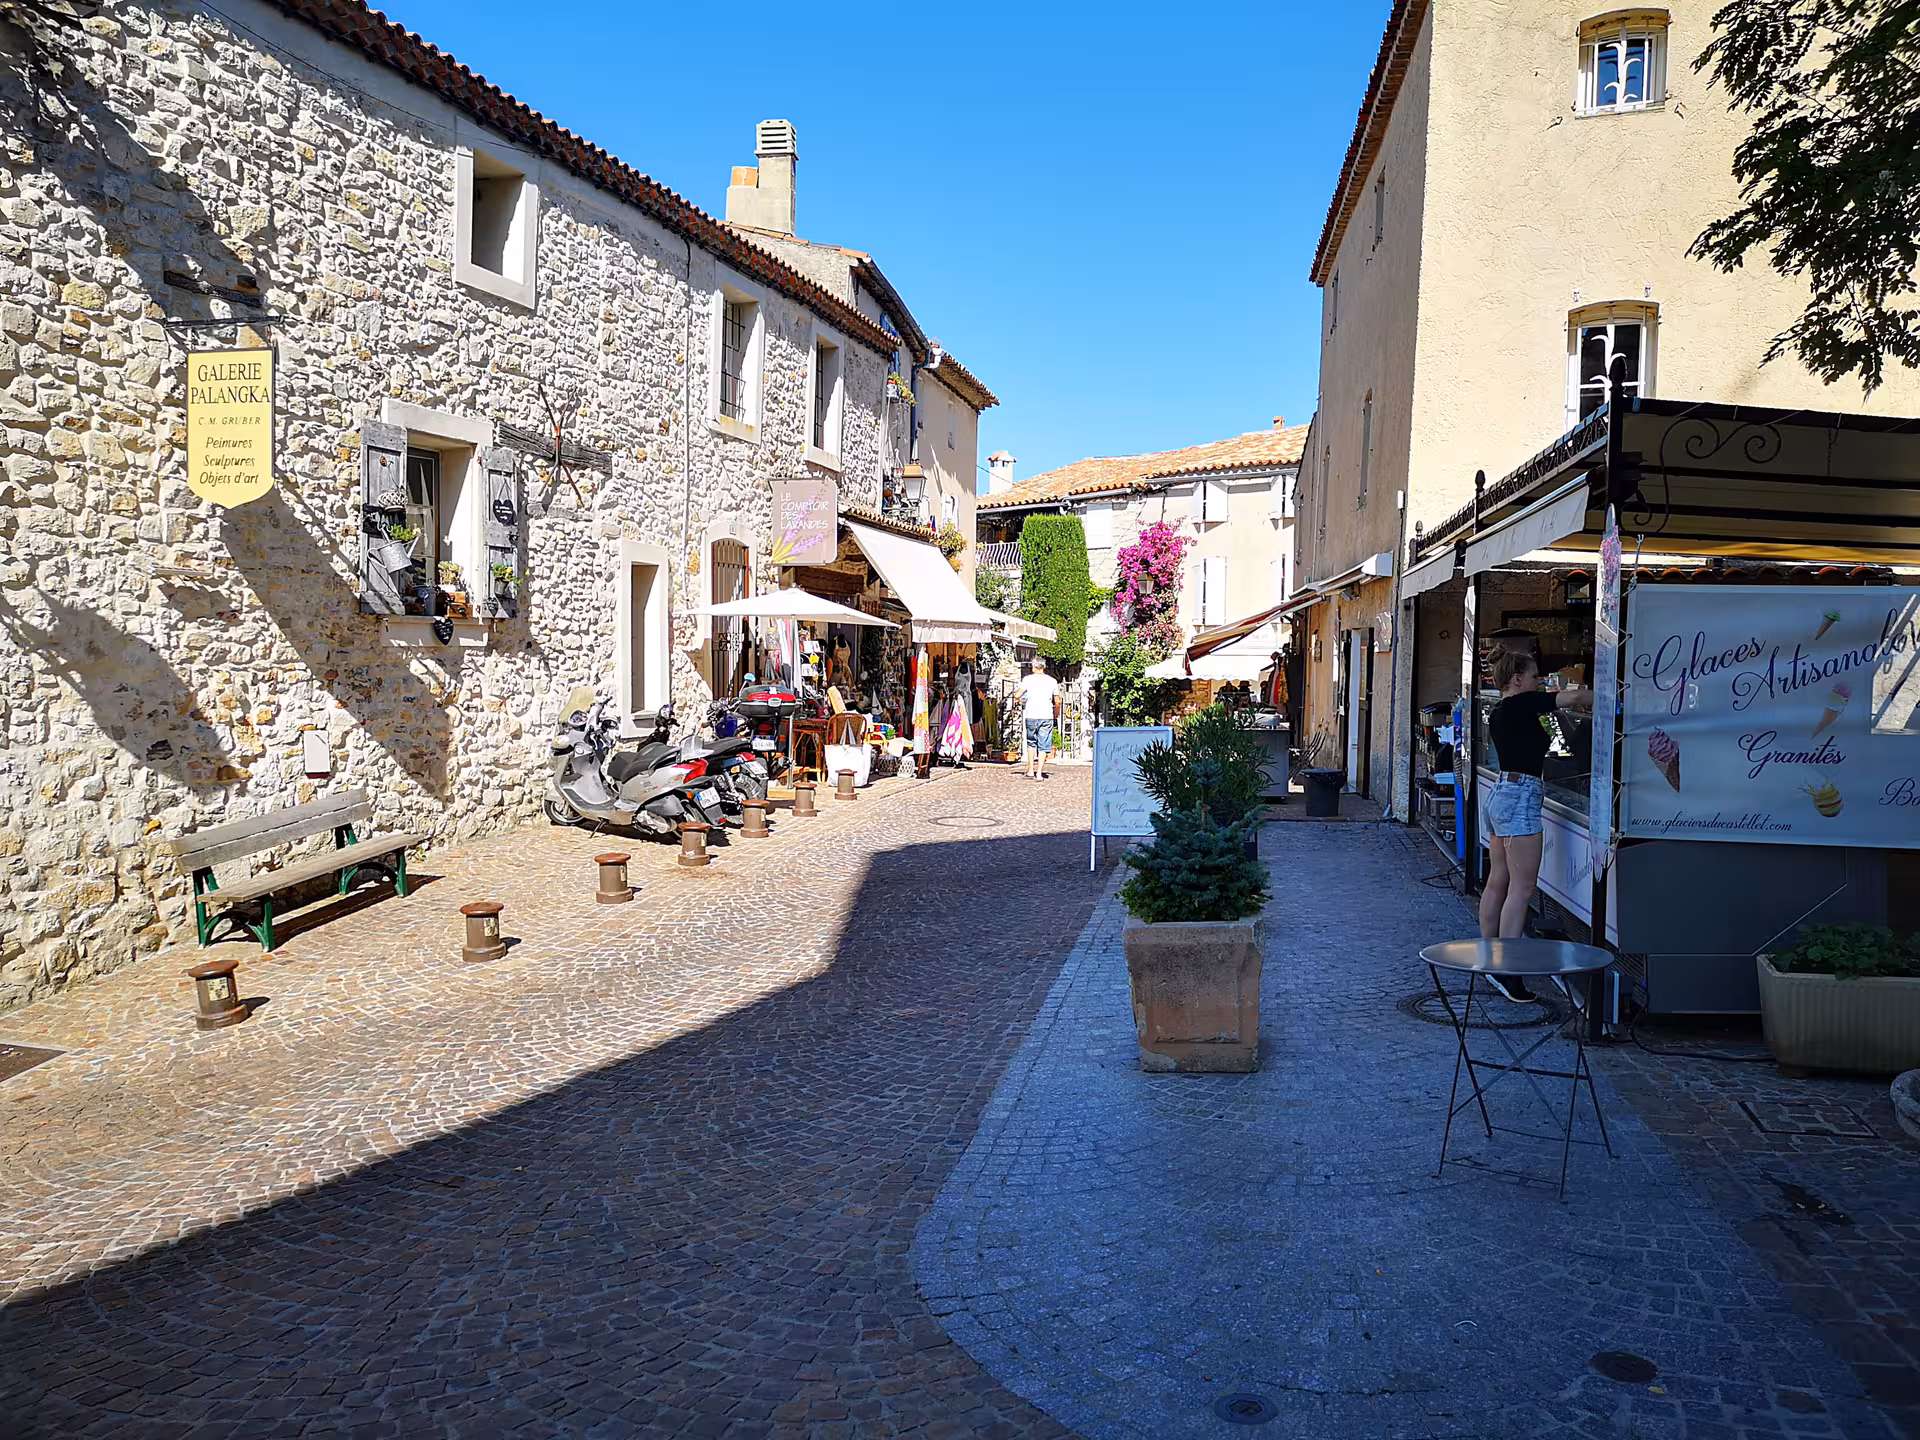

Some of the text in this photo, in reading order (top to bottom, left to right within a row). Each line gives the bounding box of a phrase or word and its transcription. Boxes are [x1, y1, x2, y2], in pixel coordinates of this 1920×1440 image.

[198, 363, 262, 382] GALERIE
[190, 385, 271, 404] PALANGKA
[222, 416, 261, 425] GRUBER
[205, 436, 253, 449] Peintures
[204, 454, 255, 469] Sculptures
[199, 471, 259, 487] Objets d'art
[780, 492, 792, 501] LE
[780, 501, 829, 511] COMPTOIR
[781, 511, 798, 520] DES
[780, 520, 829, 530] LAVANDES
[1632, 631, 1767, 716] Glaces
[1738, 730, 1846, 779] Granités
[1631, 811, 1793, 835] www.glaciersducastellet.com
